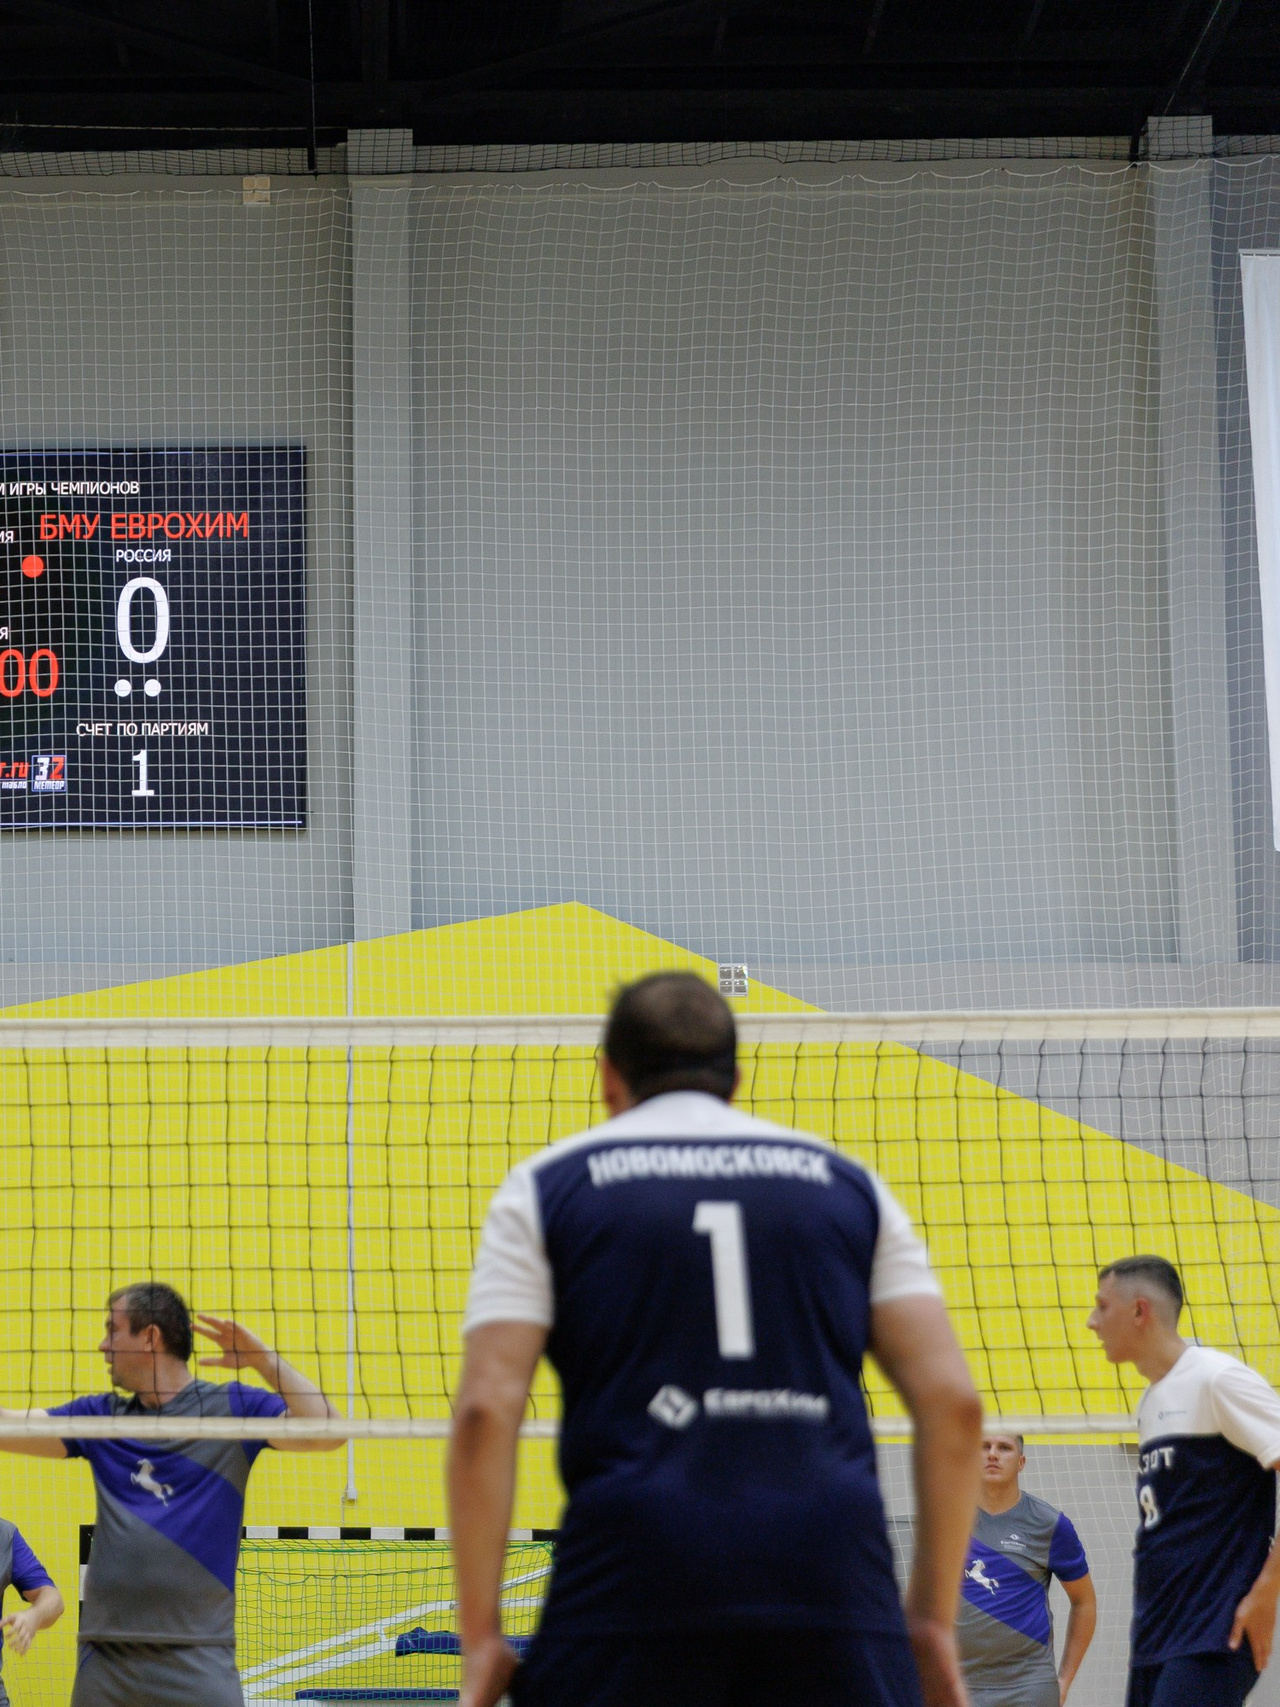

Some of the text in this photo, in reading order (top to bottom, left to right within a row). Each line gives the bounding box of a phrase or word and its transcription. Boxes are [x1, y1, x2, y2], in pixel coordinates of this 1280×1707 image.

[9, 482, 47, 496] ИГРЫ
[51, 480, 140, 495] ЧЕМПИОНОВ
[39, 511, 249, 541] БМУ ЕВРОХИМ
[115, 549, 171, 563] РОССИЯ
[117, 577, 170, 664] 0
[76, 722, 209, 737] СЧЕТ ПО ПАРТИЯМ
[131, 749, 155, 796] 1
[587, 1145, 832, 1187] НОВОМОСКОВСК
[692, 1201, 756, 1360] 1
